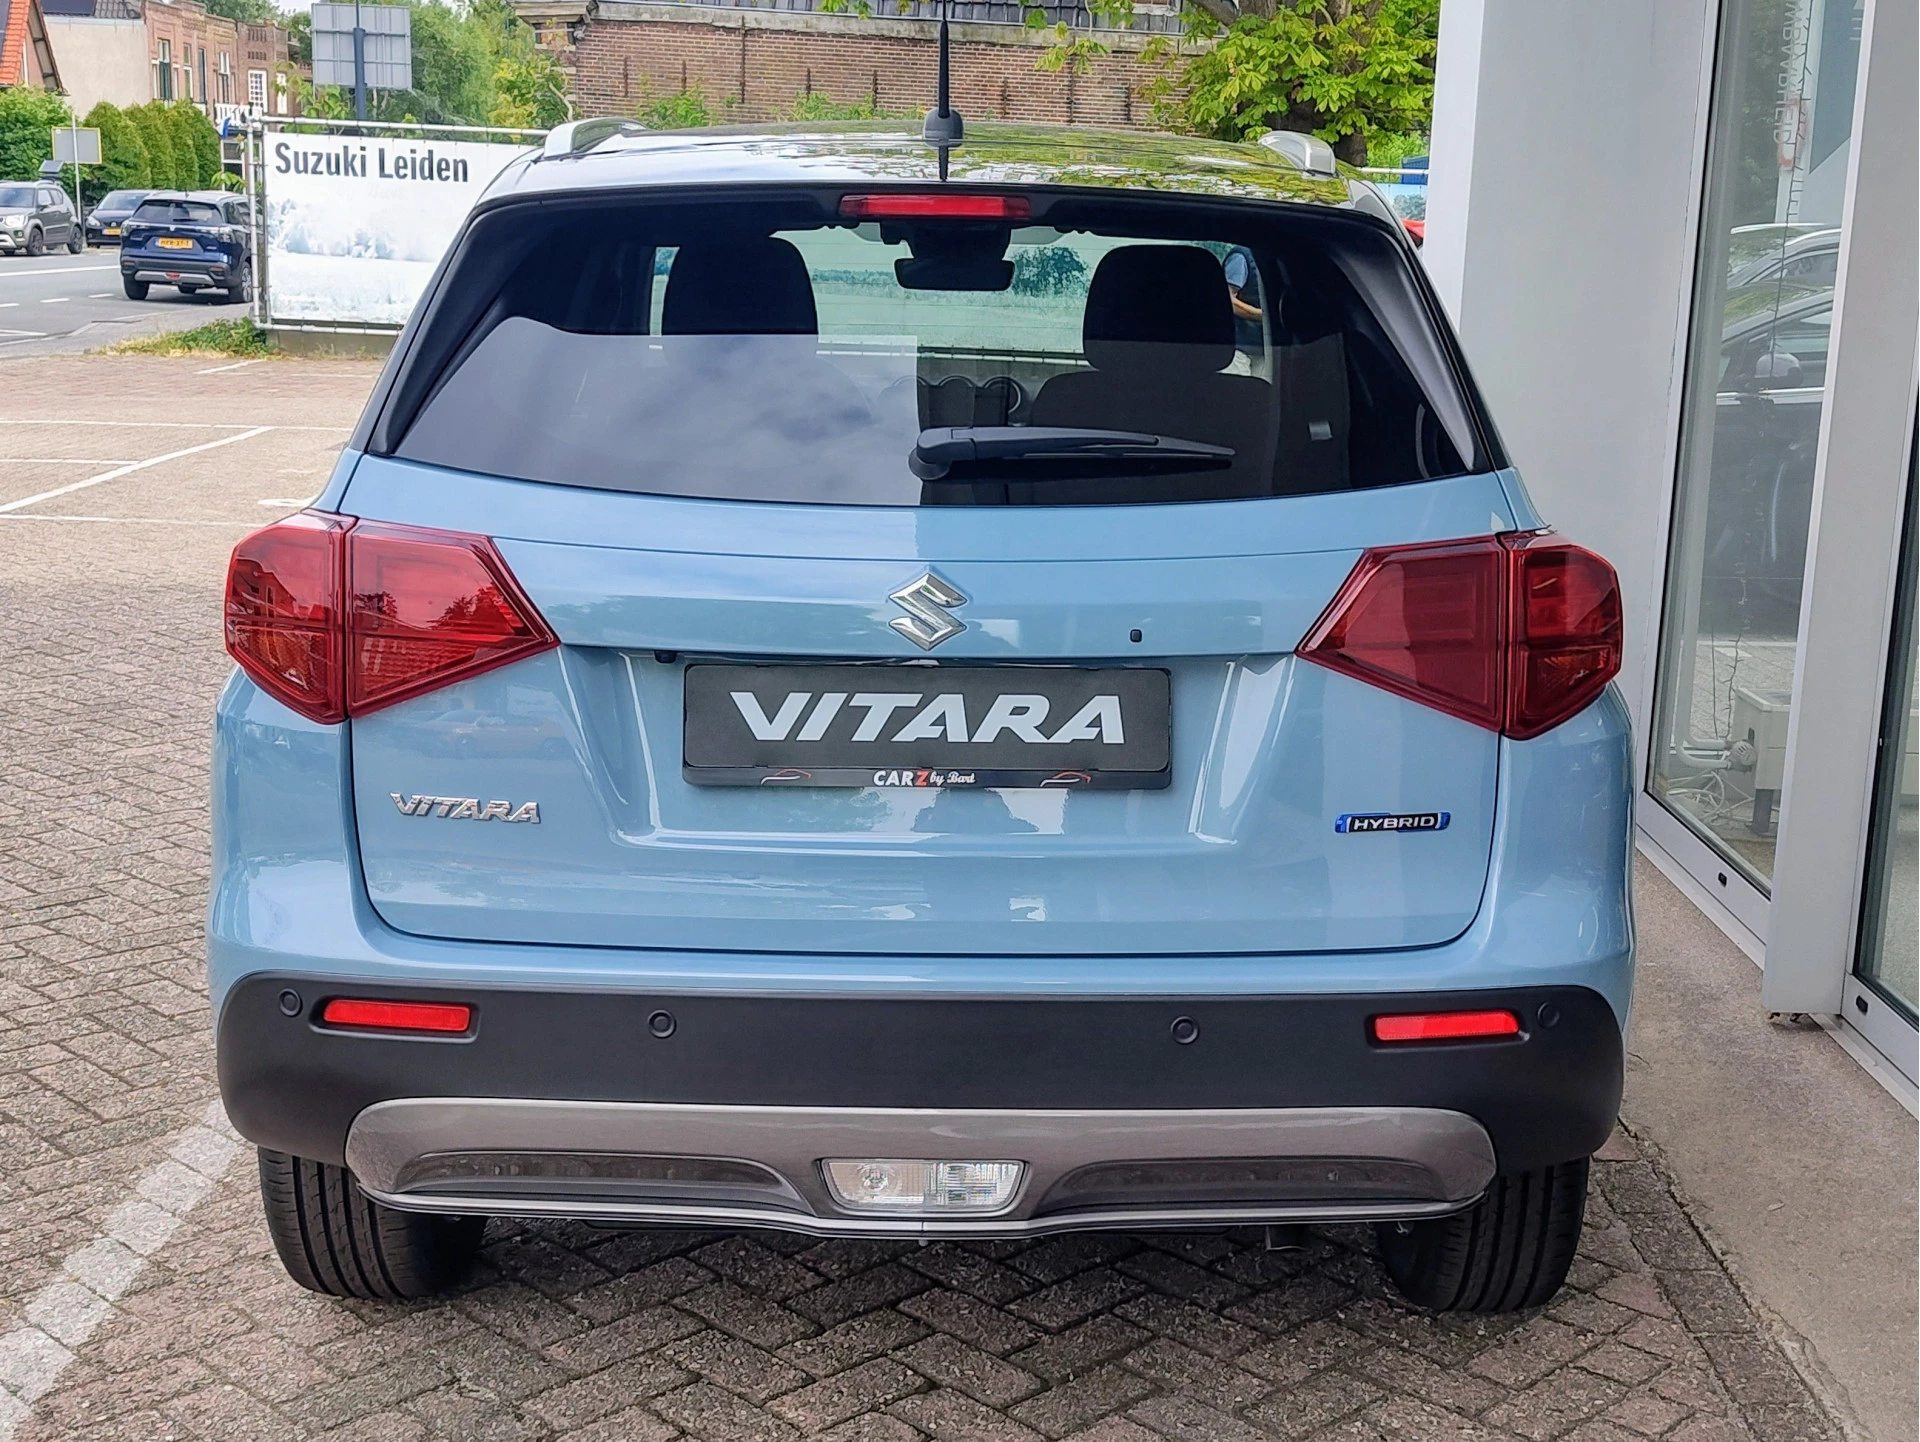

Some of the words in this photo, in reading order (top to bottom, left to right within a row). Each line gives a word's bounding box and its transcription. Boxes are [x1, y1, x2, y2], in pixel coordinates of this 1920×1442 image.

[275, 142, 367, 177] Suzuki
[378, 148, 469, 182] Leiden
[729, 691, 1126, 744] VITARA
[873, 769, 930, 787] CARZ
[930, 771, 945, 786] by
[947, 770, 976, 784] Bart
[390, 792, 541, 824] VITARA
[1354, 816, 1435, 830] HYBRID
